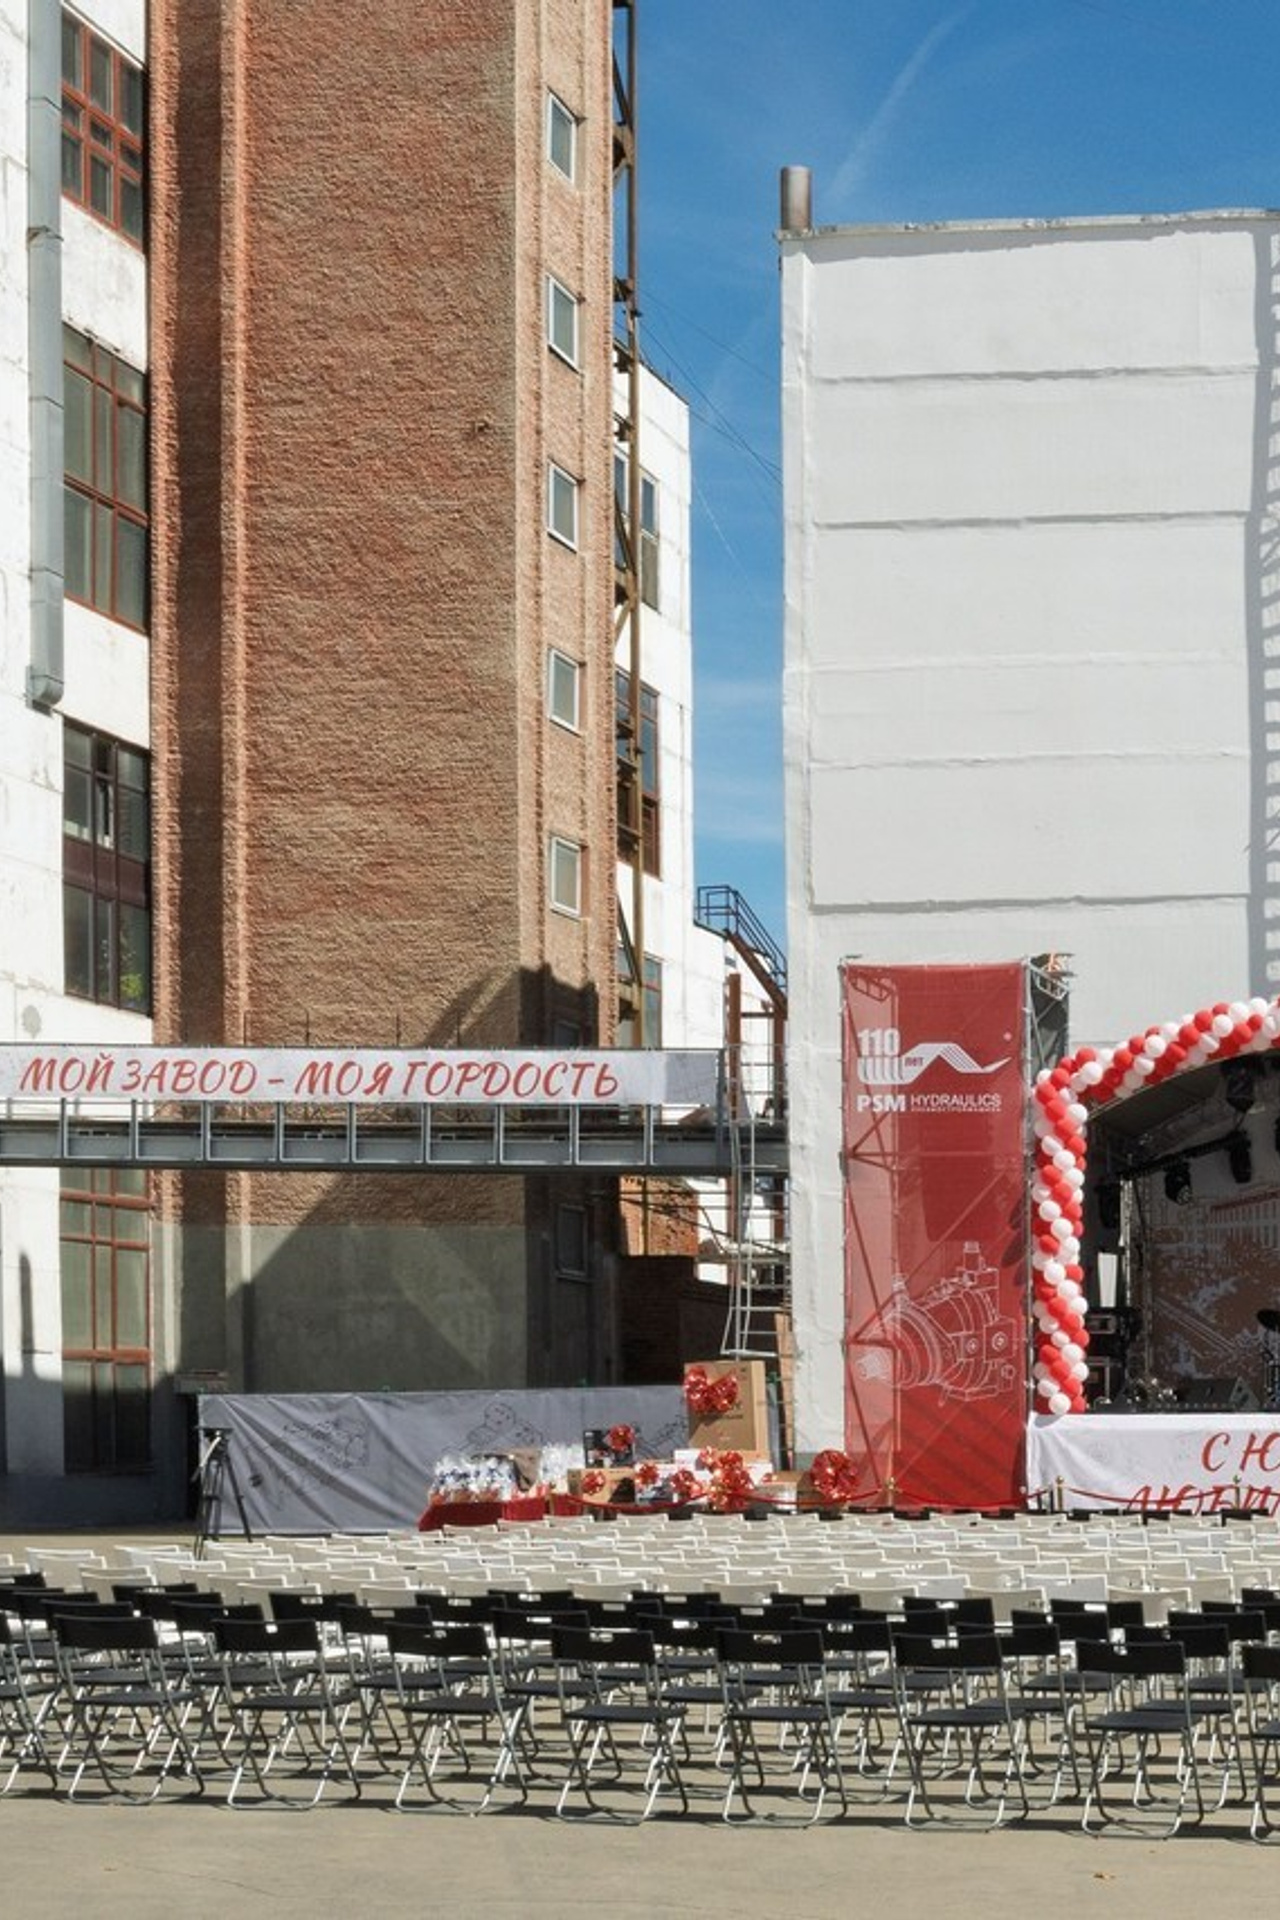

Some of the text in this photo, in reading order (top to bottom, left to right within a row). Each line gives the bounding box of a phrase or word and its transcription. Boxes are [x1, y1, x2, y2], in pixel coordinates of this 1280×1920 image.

[858, 1029, 900, 1056] 110
[19, 1052, 115, 1093] МОЙ
[121, 1059, 257, 1095] ЗАВОД
[294, 1060, 394, 1096] МОЯ
[402, 1060, 618, 1097] ГОРДОСТЬ
[857, 1093, 1002, 1112] PSM HYDRAULICS
[1201, 1432, 1231, 1471] С
